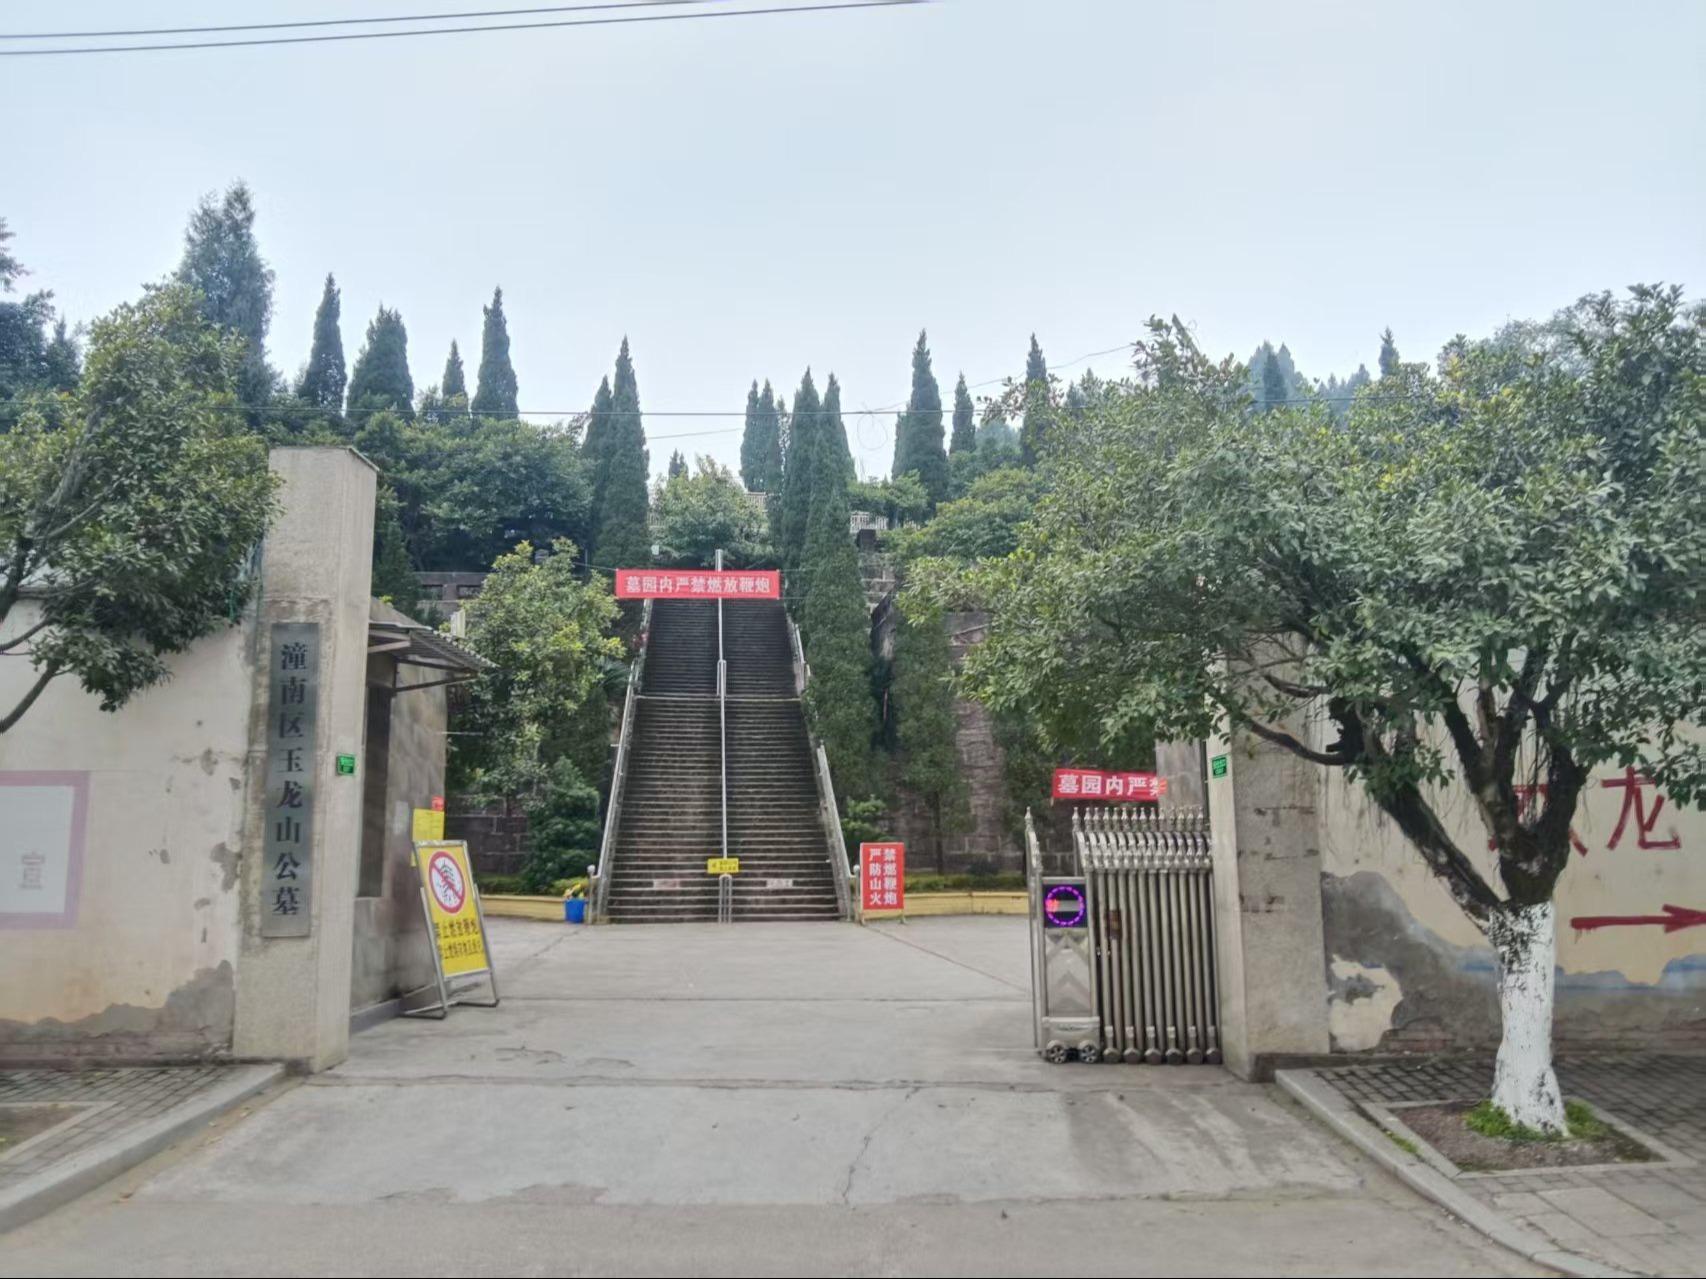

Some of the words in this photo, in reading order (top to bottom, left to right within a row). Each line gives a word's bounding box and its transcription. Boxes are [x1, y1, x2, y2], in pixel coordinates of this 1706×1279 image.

[626, 576, 770, 593] 墓园内严禁燃放鞭炮
[272, 642, 308, 916] 潼南区玉龙山公墓
[869, 848, 882, 906] 严防山火
